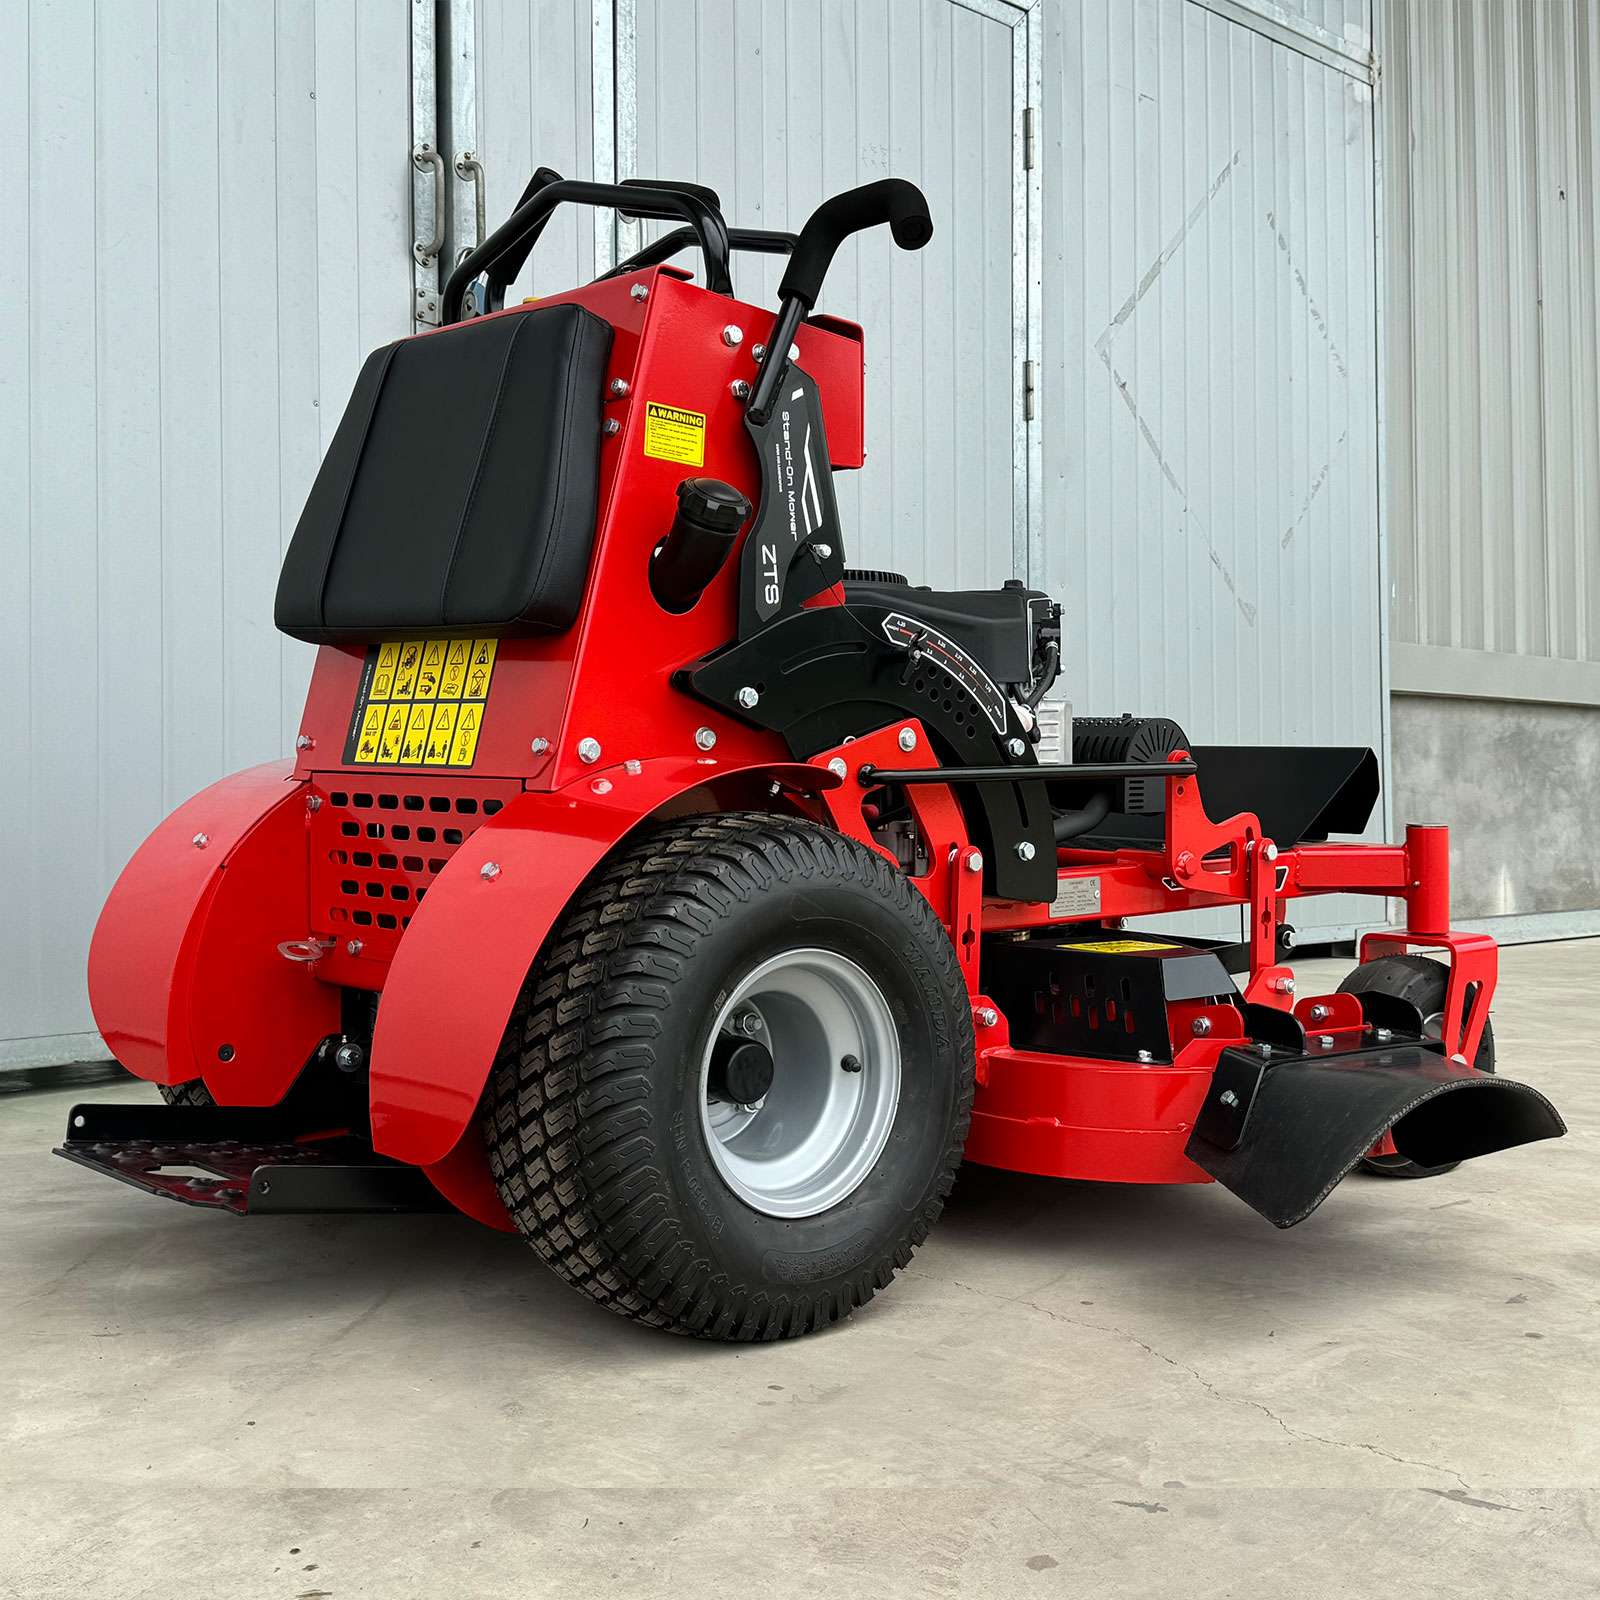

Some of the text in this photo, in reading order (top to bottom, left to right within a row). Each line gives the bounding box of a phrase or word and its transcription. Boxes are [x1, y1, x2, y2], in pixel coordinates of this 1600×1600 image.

[658, 408, 703, 427] WARNING
[782, 411, 797, 541] Stand-On Mower
[761, 544, 780, 605] ZTS
